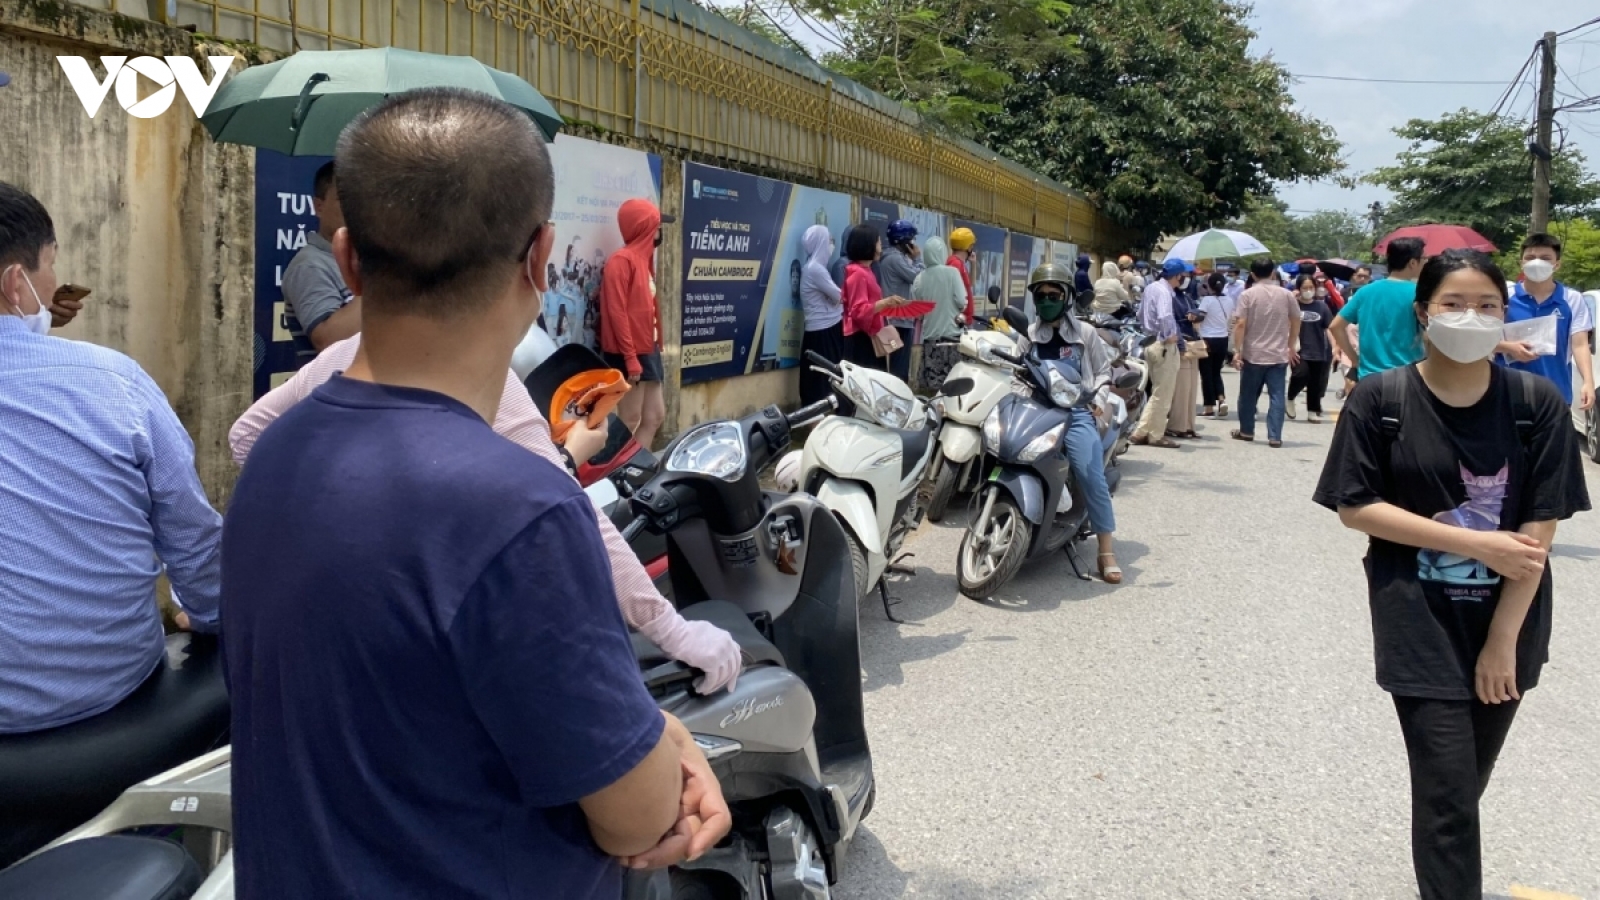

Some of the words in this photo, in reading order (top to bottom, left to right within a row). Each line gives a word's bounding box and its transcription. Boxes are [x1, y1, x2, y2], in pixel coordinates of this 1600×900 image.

[277, 224, 315, 250] NĂ
[690, 224, 725, 251] TIẾNG
[725, 234, 750, 252] ANH
[693, 261, 717, 277] CHUẨN
[718, 266, 753, 276] CAMBRIDGE
[713, 315, 736, 324] Cambridge
